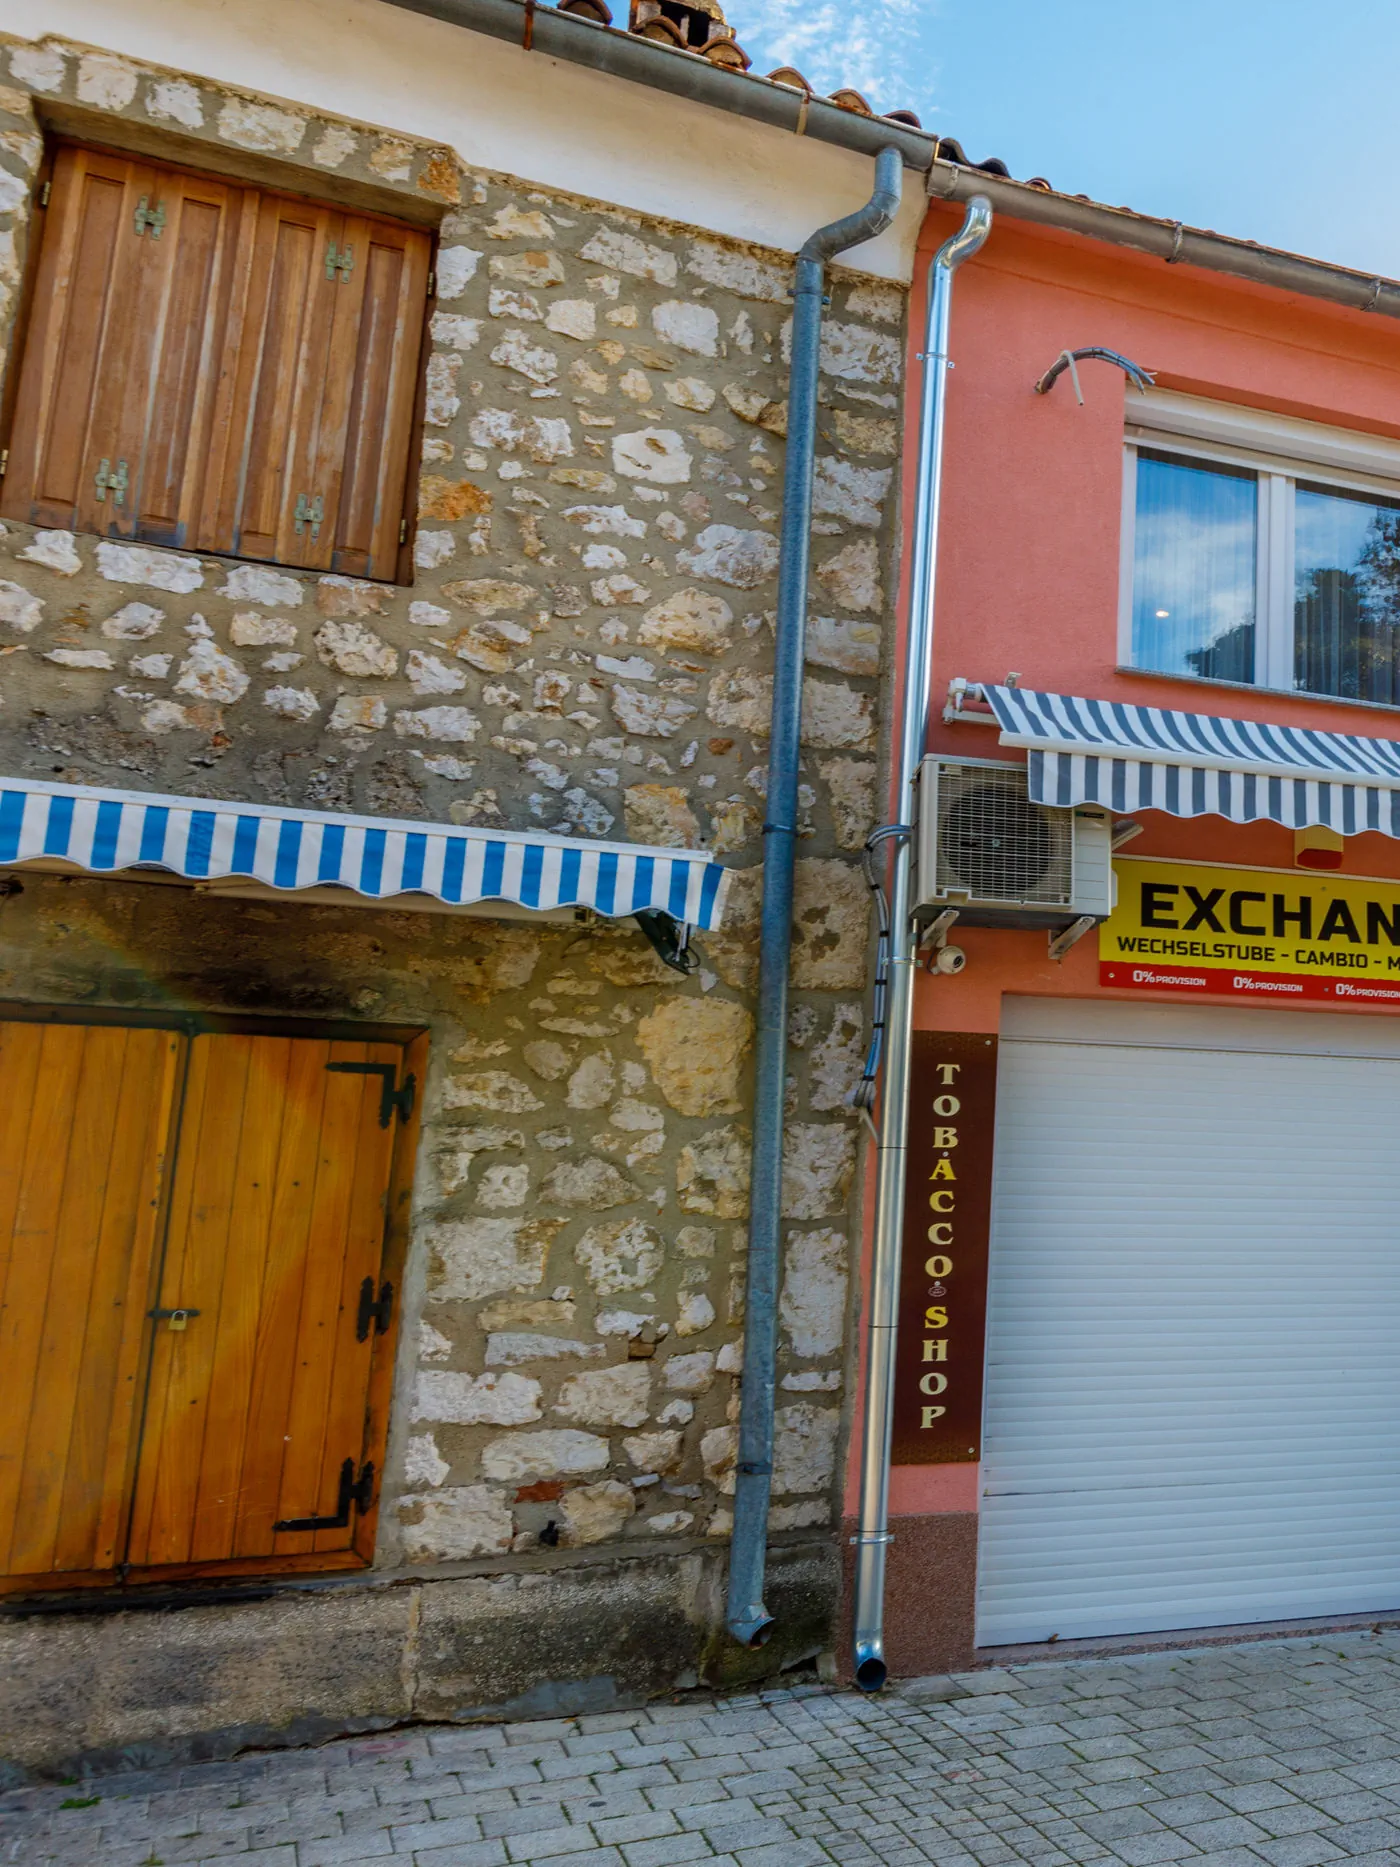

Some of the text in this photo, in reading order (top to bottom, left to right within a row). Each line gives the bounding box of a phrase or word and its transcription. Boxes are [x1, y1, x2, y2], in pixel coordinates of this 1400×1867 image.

[1116, 935, 1276, 962] WECHSELSTUBE
[1295, 949, 1369, 969] CAMBIO
[1132, 969, 1155, 983] 0%
[1155, 975, 1207, 987] PROVISION
[1233, 976, 1255, 989] 0%
[1255, 981, 1303, 993] PROVISION
[1335, 982, 1356, 996] 0%
[924, 1063, 961, 1278] TOBACCO
[919, 1305, 949, 1430] SHOP
